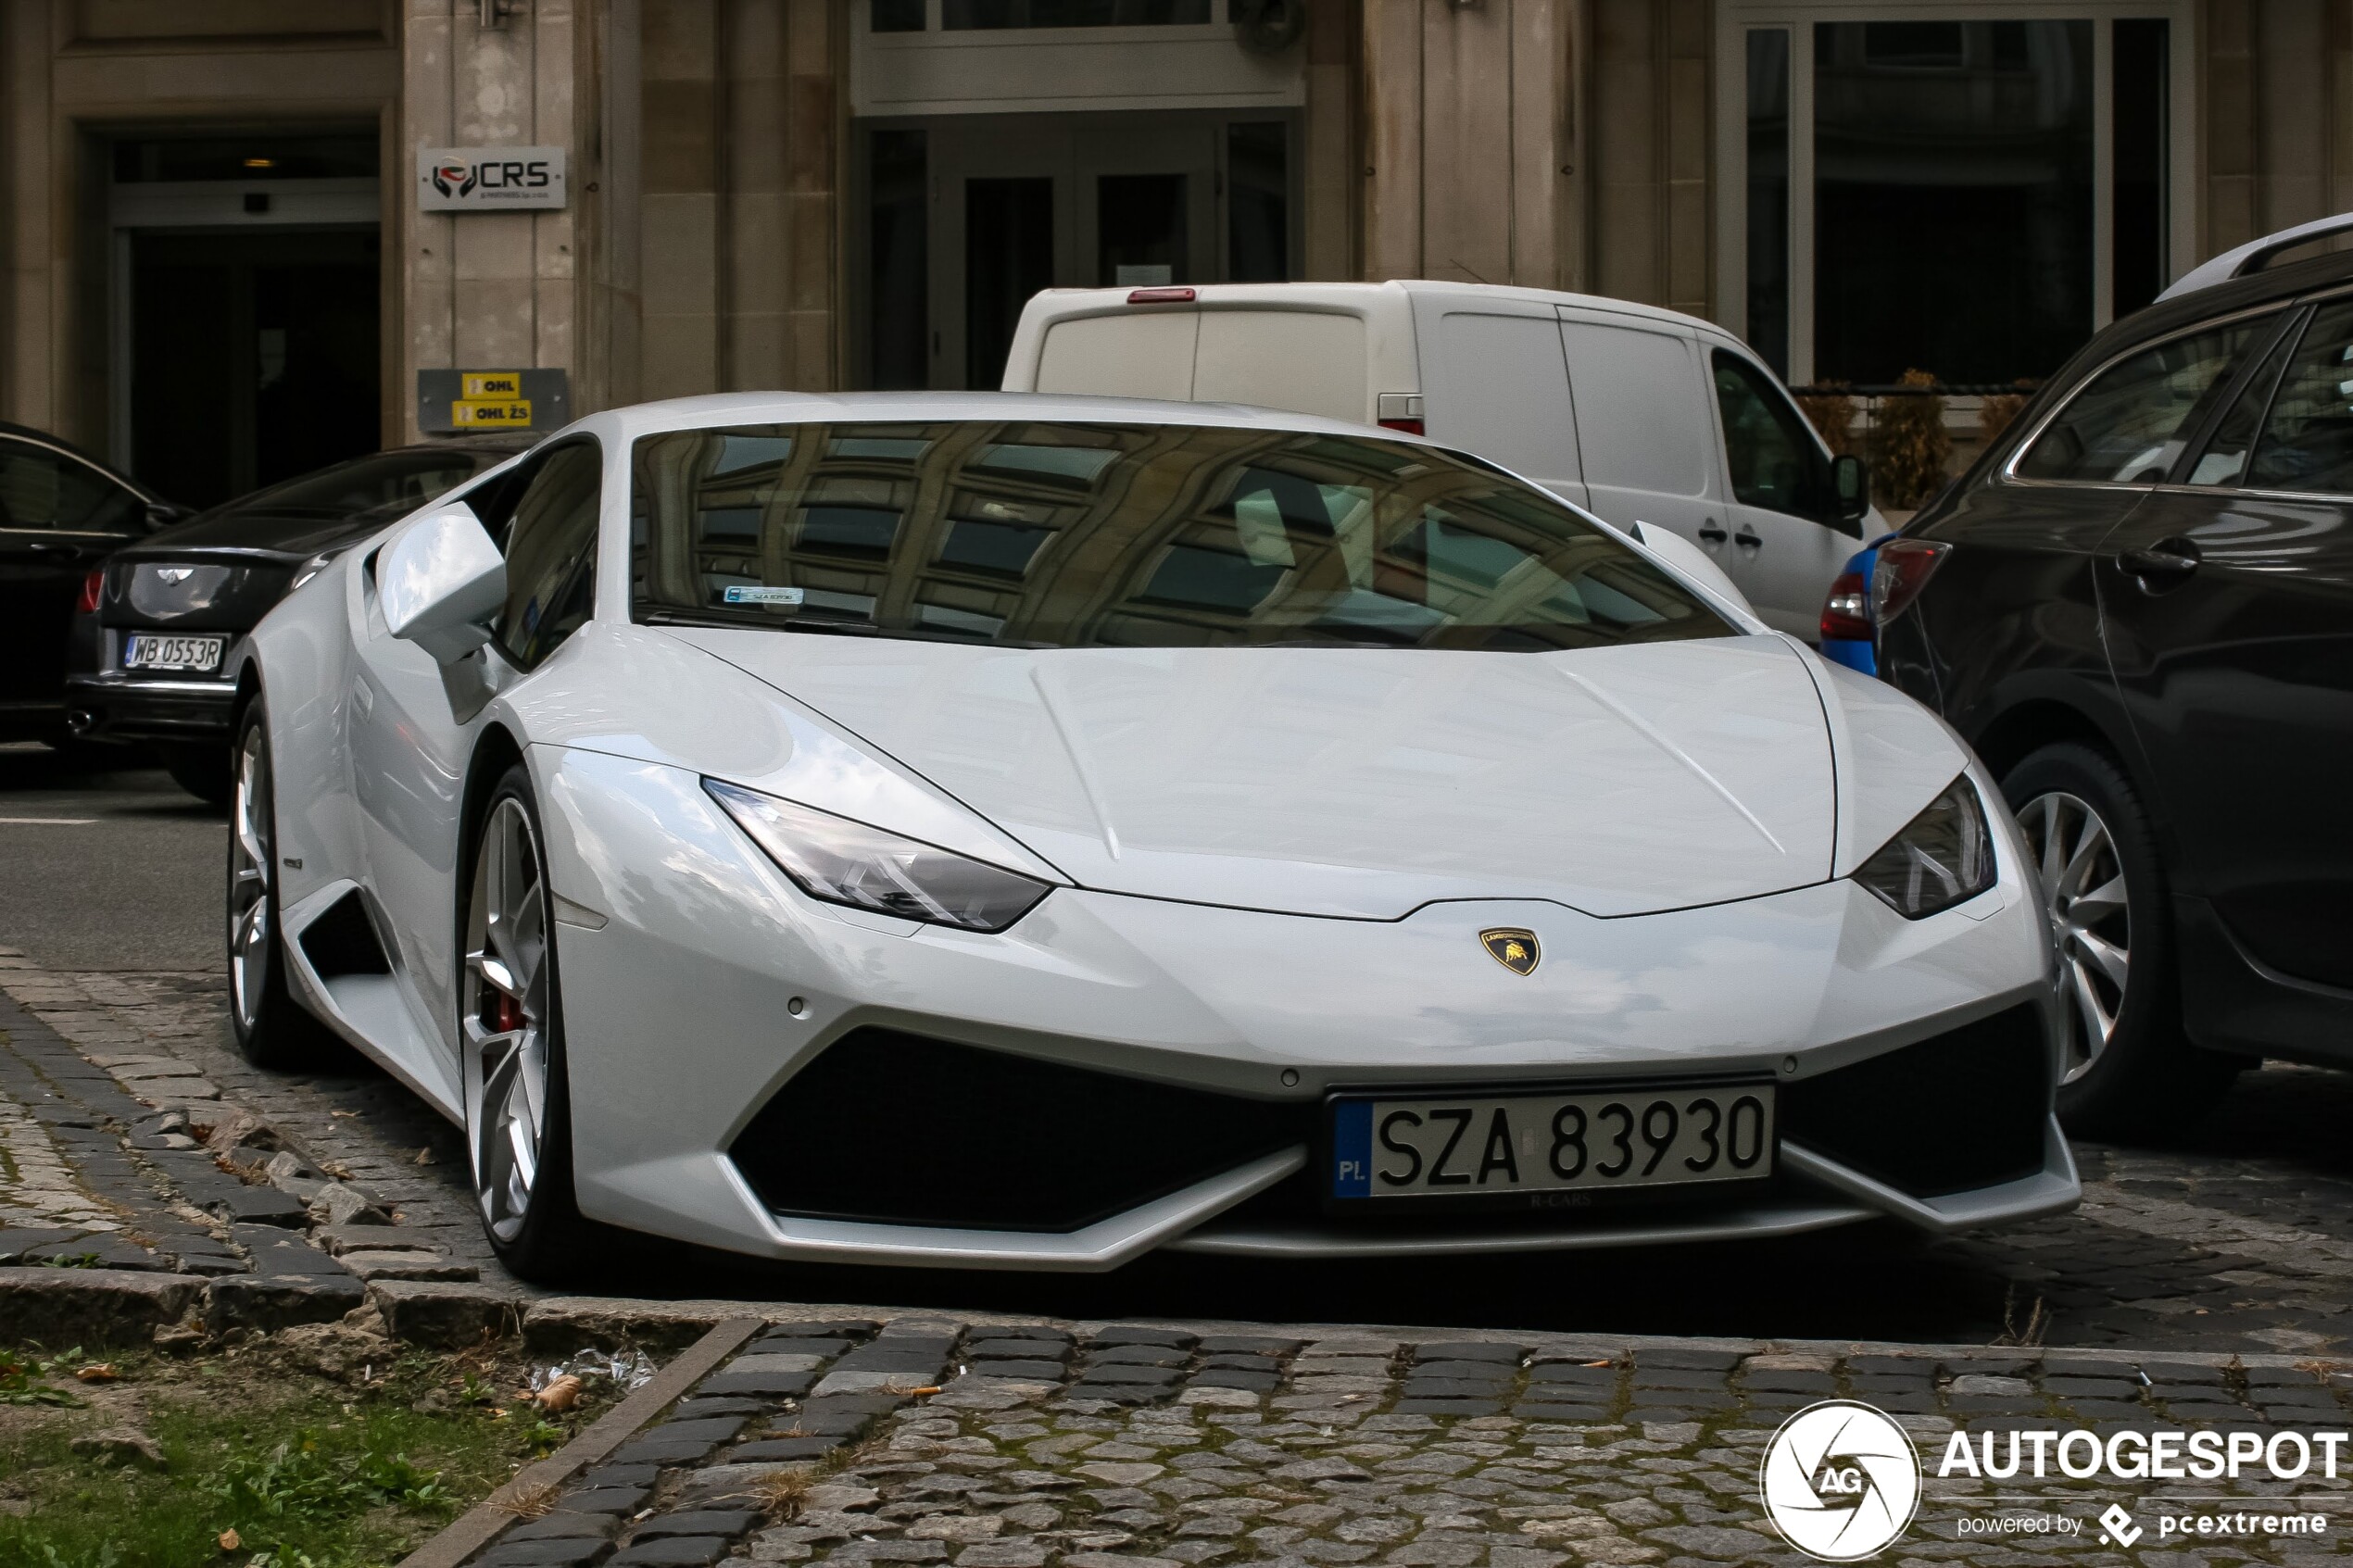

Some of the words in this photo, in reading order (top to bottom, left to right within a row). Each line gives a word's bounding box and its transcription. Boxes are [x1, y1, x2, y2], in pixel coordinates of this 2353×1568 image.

[480, 161, 548, 187] CRS
[484, 381, 514, 392] OHL
[476, 408, 505, 420] OHL
[134, 638, 158, 662] WB
[162, 639, 219, 665] 0553R
[1378, 1107, 1519, 1186] SZA
[1549, 1095, 1765, 1180] 83930
[1340, 1160, 1365, 1181] PL
[1530, 1193, 1592, 1209] R-CARS
